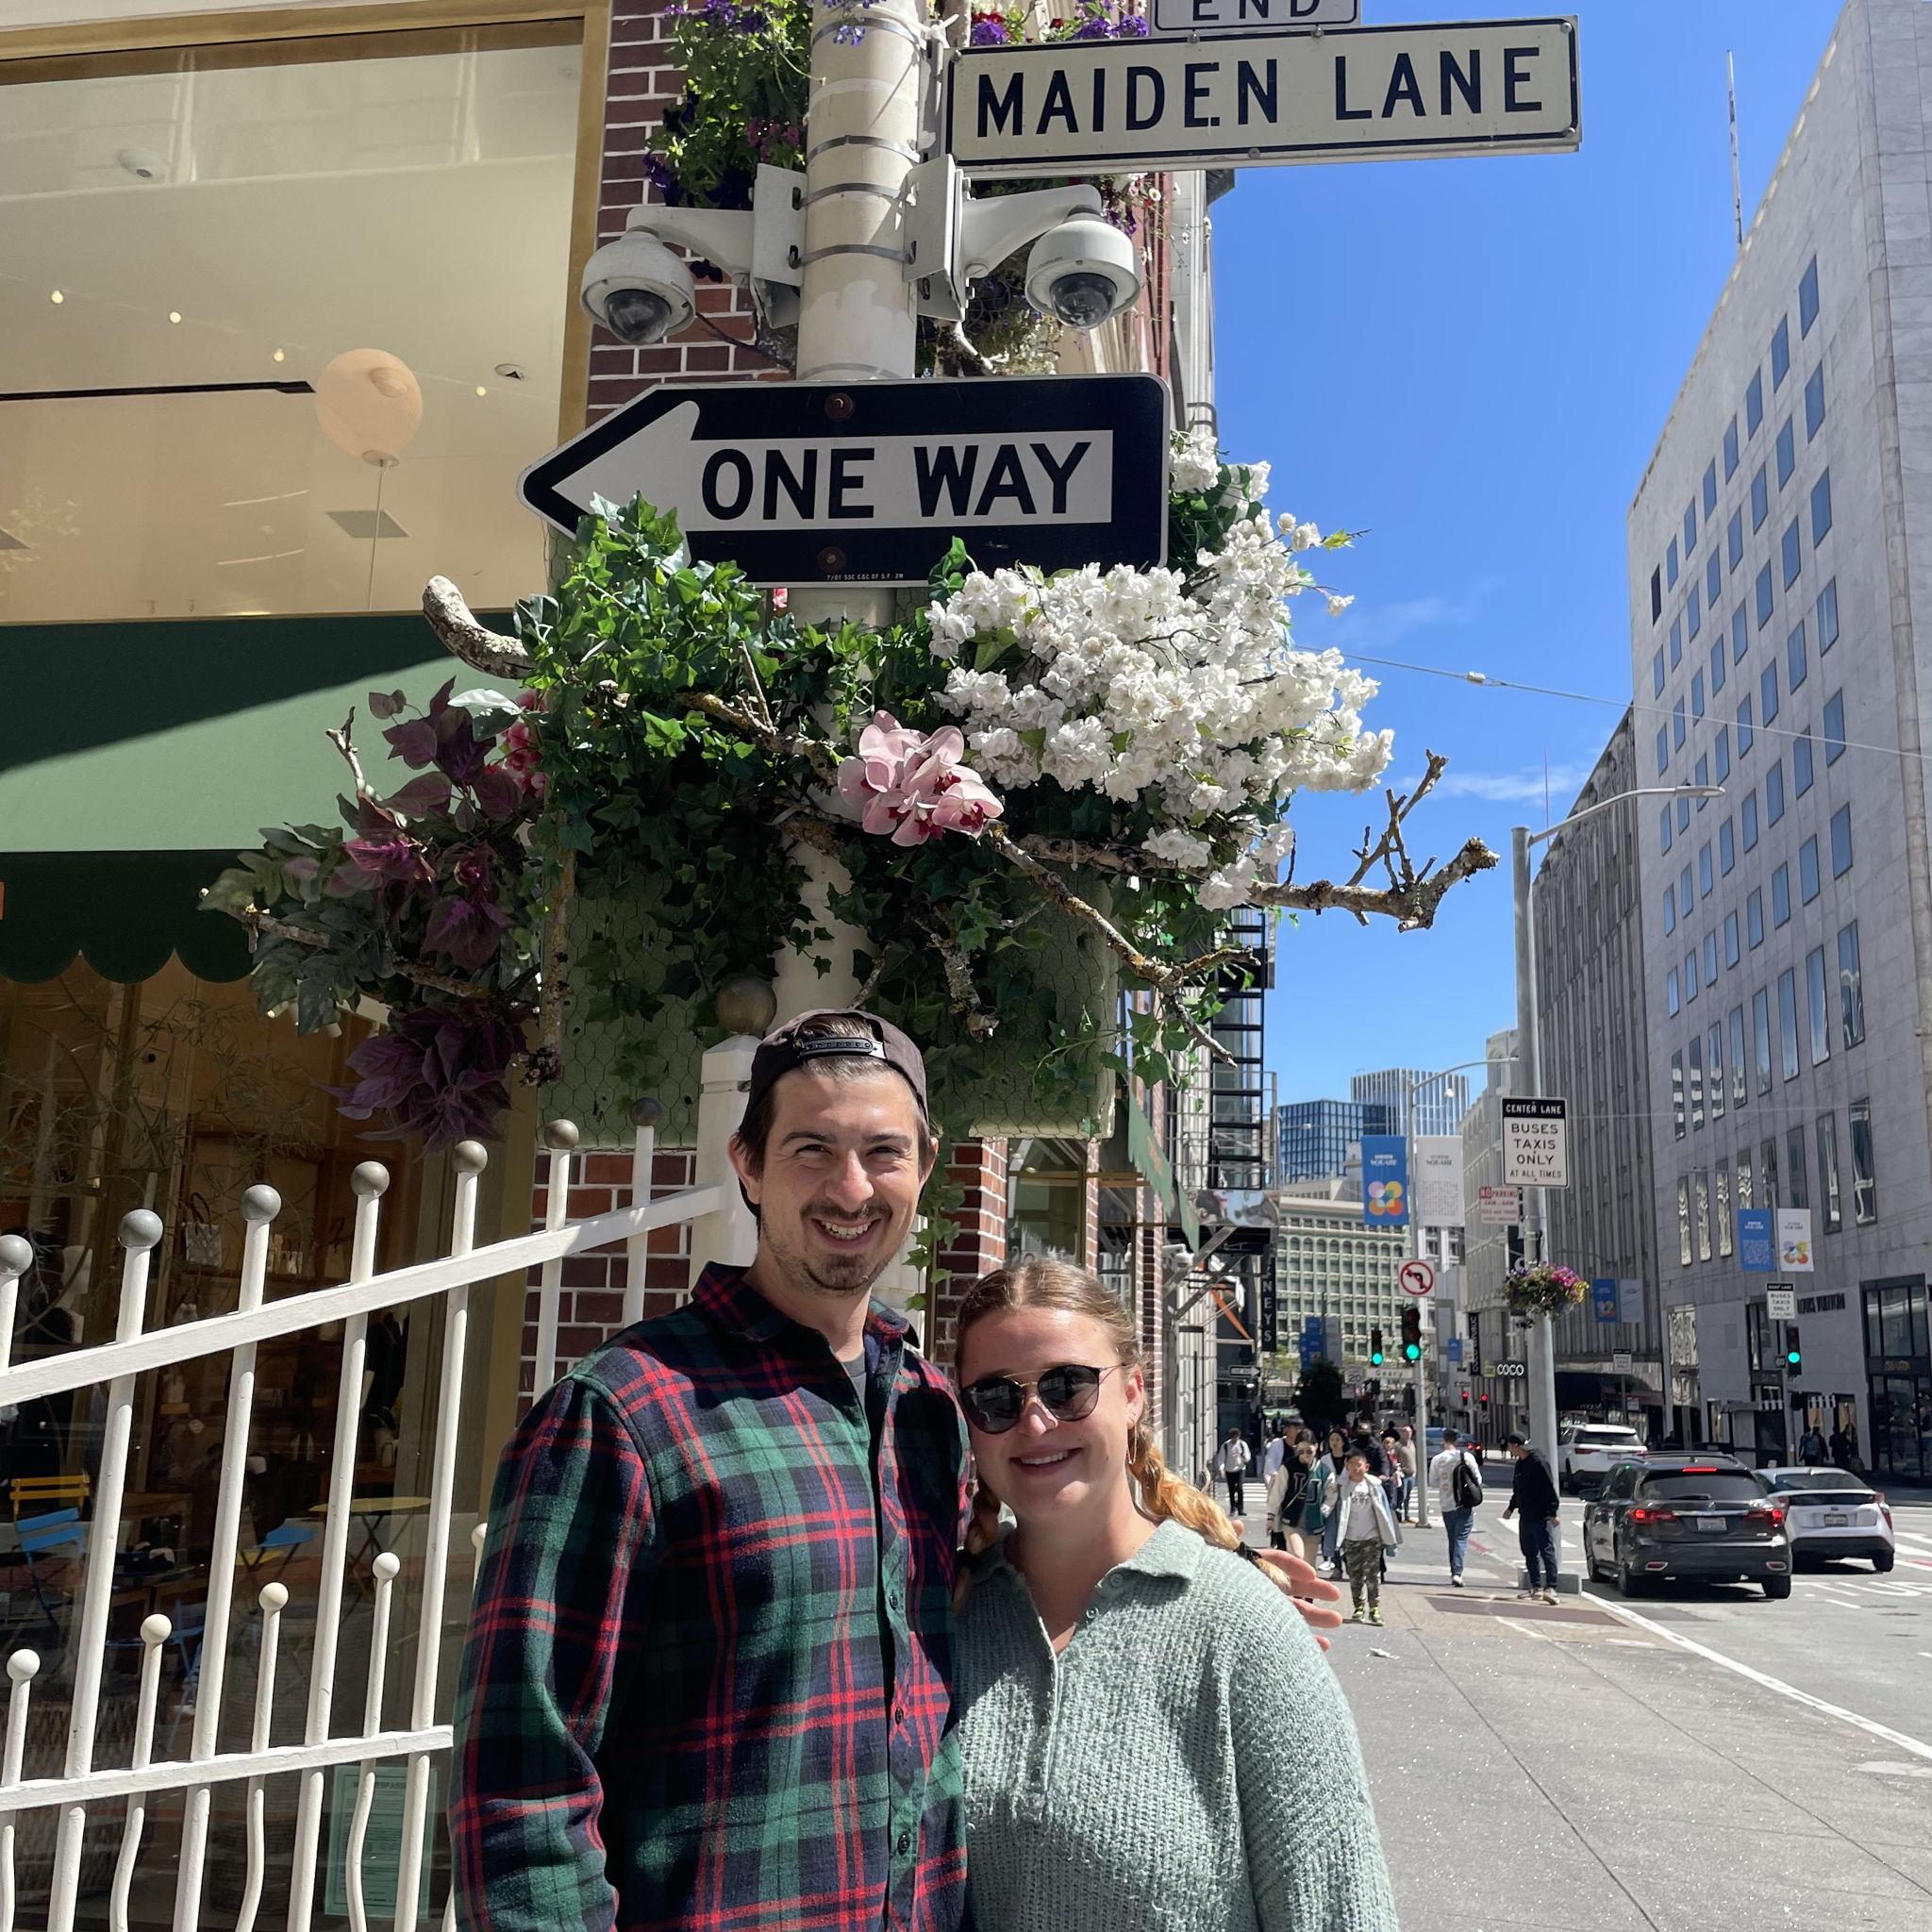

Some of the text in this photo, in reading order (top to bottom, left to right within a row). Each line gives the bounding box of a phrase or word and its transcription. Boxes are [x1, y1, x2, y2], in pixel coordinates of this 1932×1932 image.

[977, 46, 1543, 138] MAIDEN LANE
[701, 441, 1092, 521] ONE WAY
[1506, 1104, 1562, 1115] CENTER LANE
[1511, 1123, 1558, 1135] BUSES
[1513, 1138, 1556, 1150] TAXIS
[1516, 1154, 1554, 1165] ONLY
[1522, 1170, 1535, 1178] ALL
[1540, 1170, 1562, 1178] TIMES
